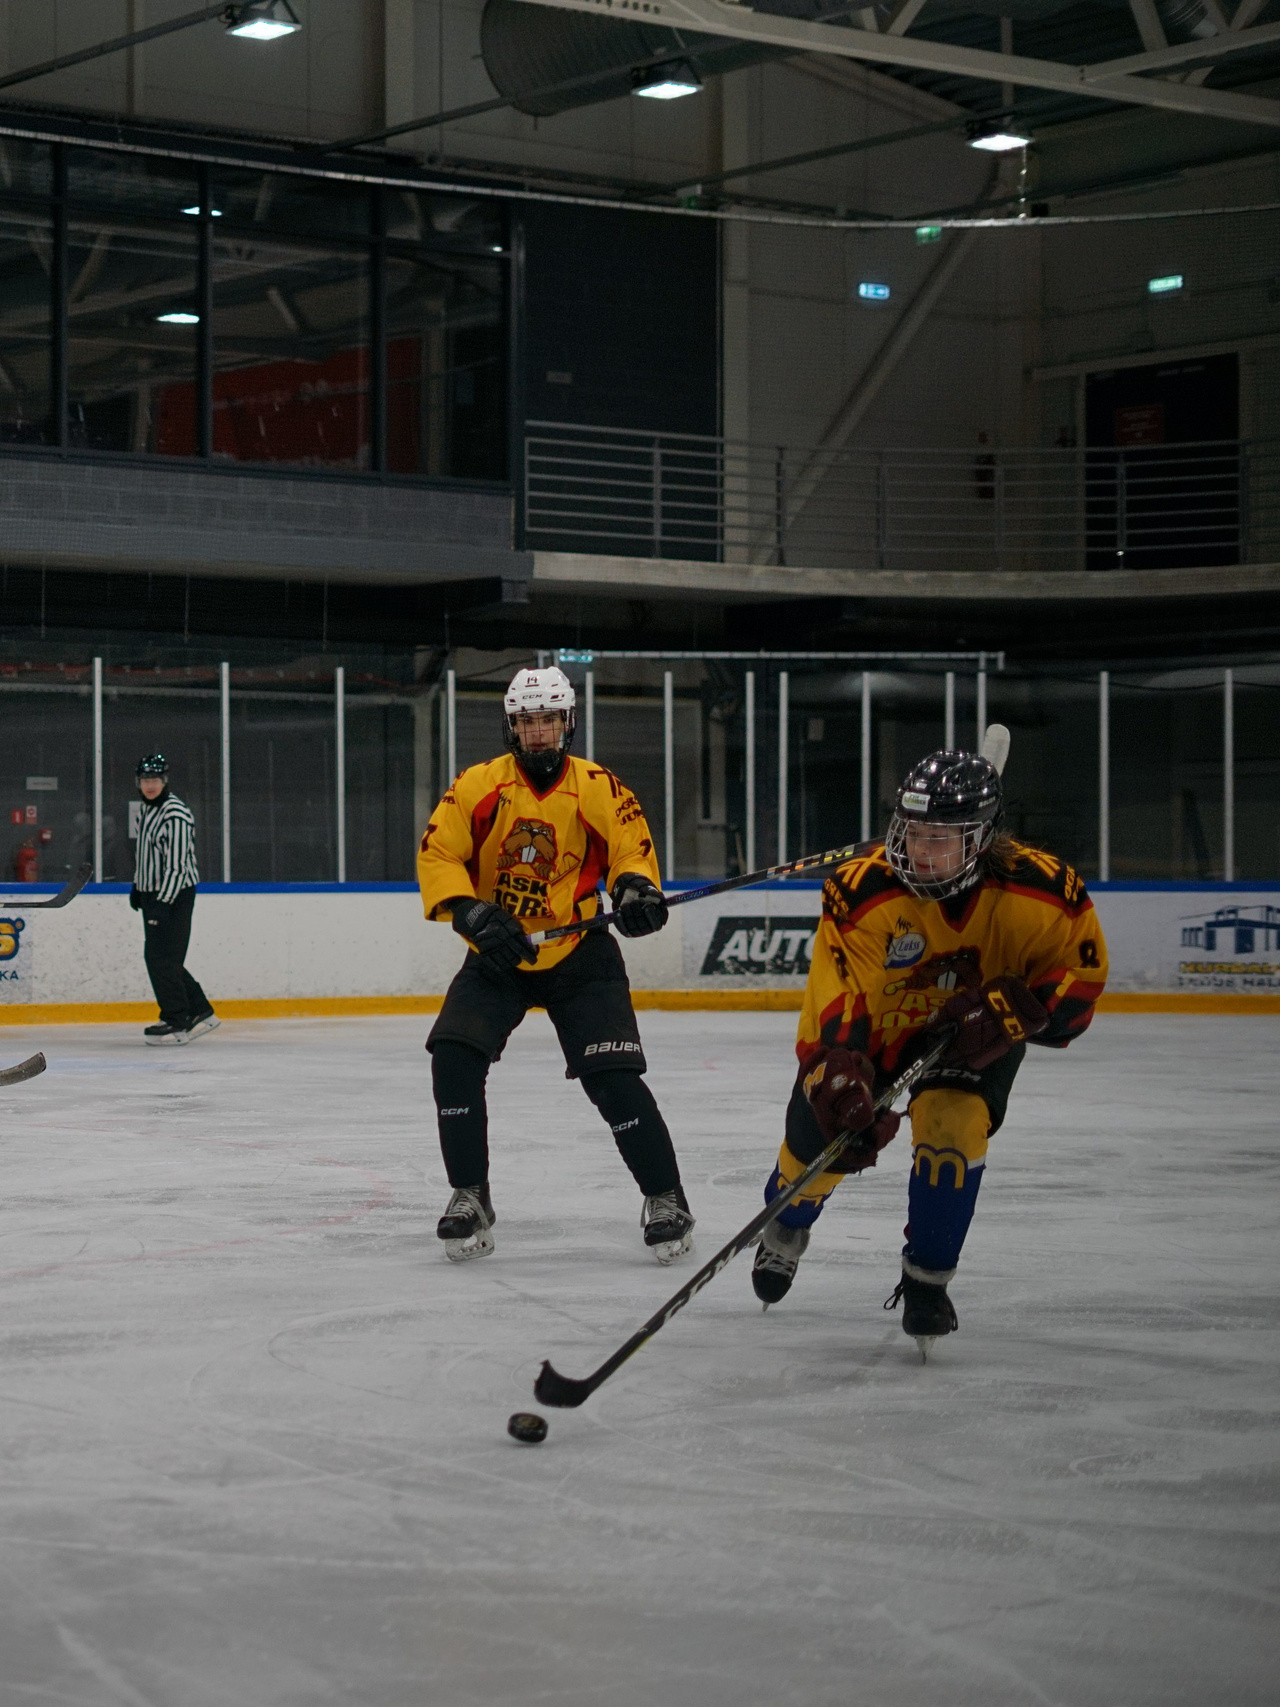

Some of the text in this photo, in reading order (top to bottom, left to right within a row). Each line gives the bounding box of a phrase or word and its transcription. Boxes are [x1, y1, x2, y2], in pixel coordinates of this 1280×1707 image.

[497, 870, 548, 897] ASK
[583, 1040, 642, 1057] BAUER
[440, 1106, 469, 1116] CCM
[611, 1117, 640, 1133] CCM
